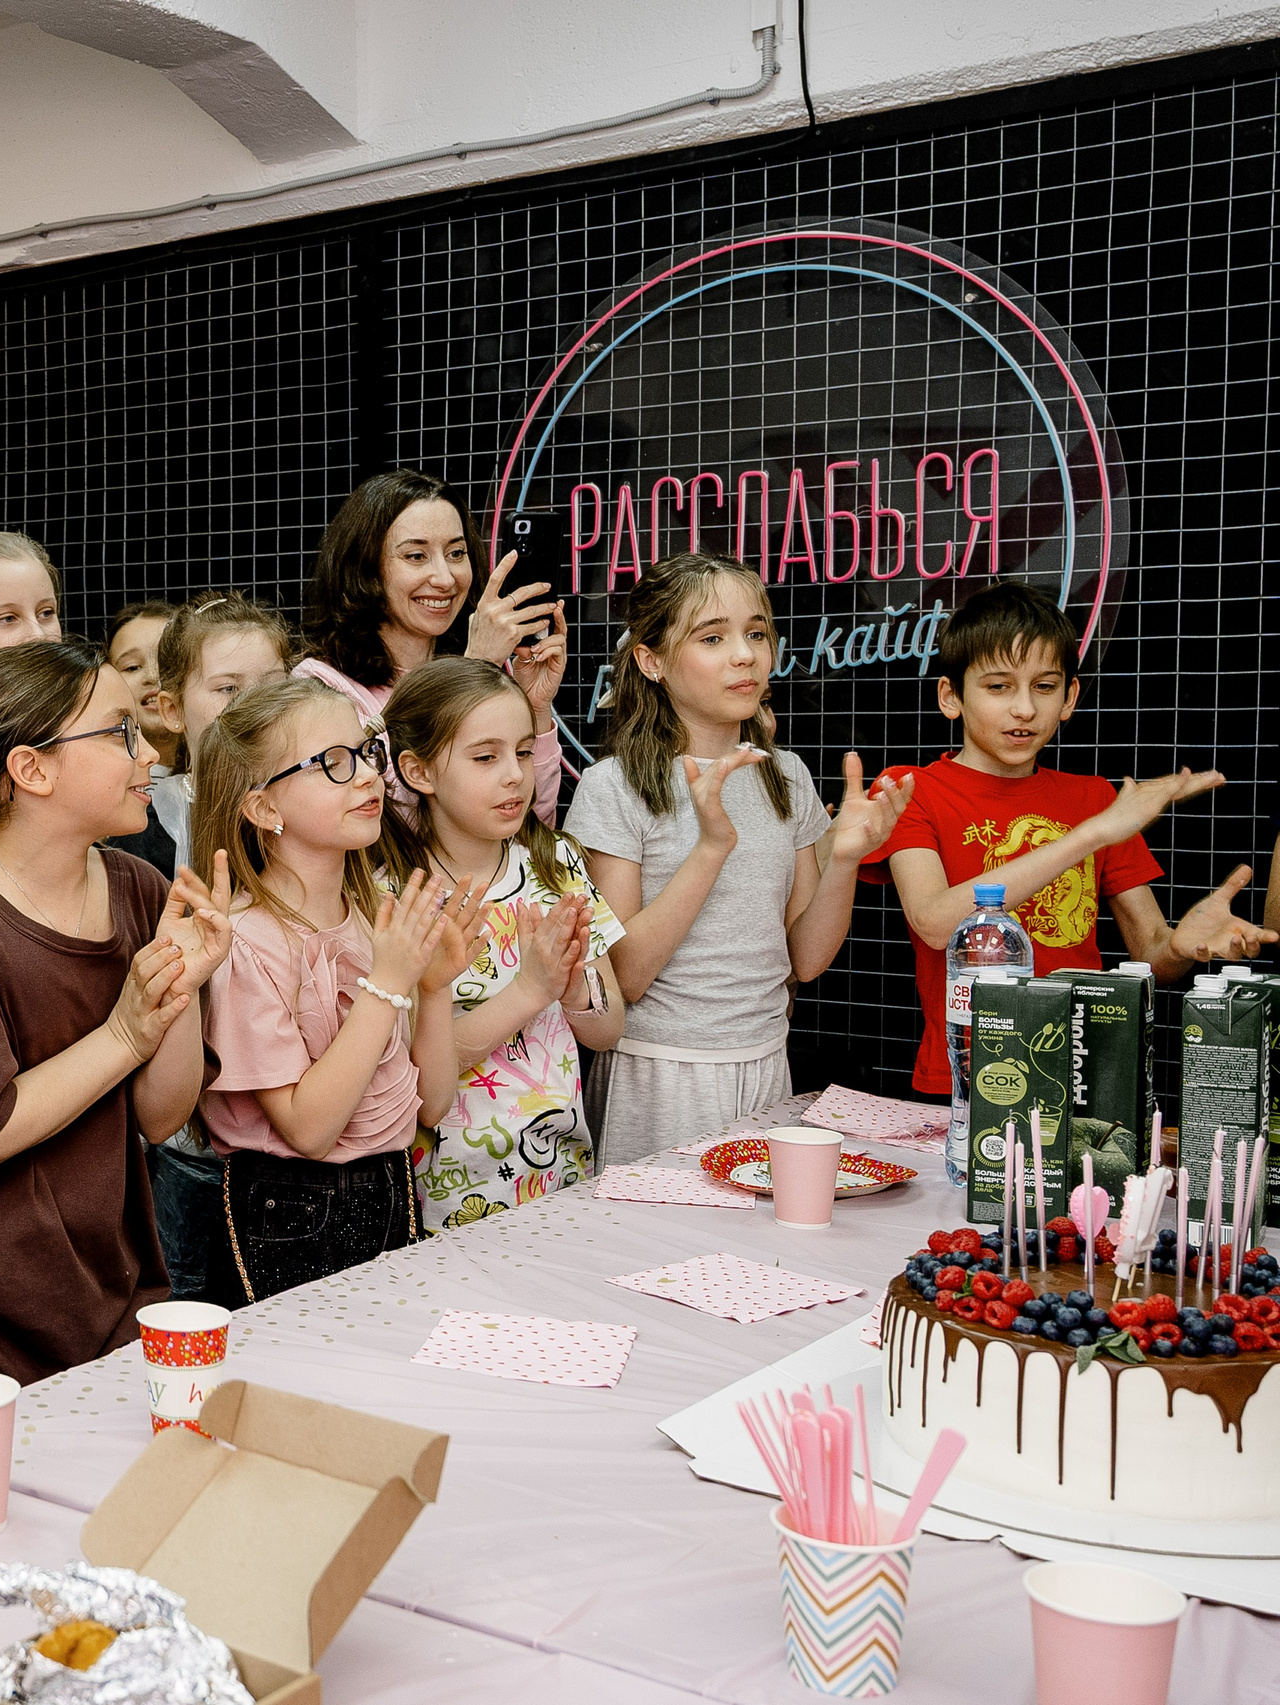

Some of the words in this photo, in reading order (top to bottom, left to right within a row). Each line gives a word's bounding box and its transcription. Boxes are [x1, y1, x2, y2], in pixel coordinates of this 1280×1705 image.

[962, 818, 1002, 847] 武术
[978, 1009, 998, 1017] бери
[1090, 1004, 1128, 1016] 100%
[982, 1075, 1021, 1087] СОК
[974, 1169, 1006, 1177] БОЛЬШ
[1024, 1181, 1062, 1189] ДОРЫМ
